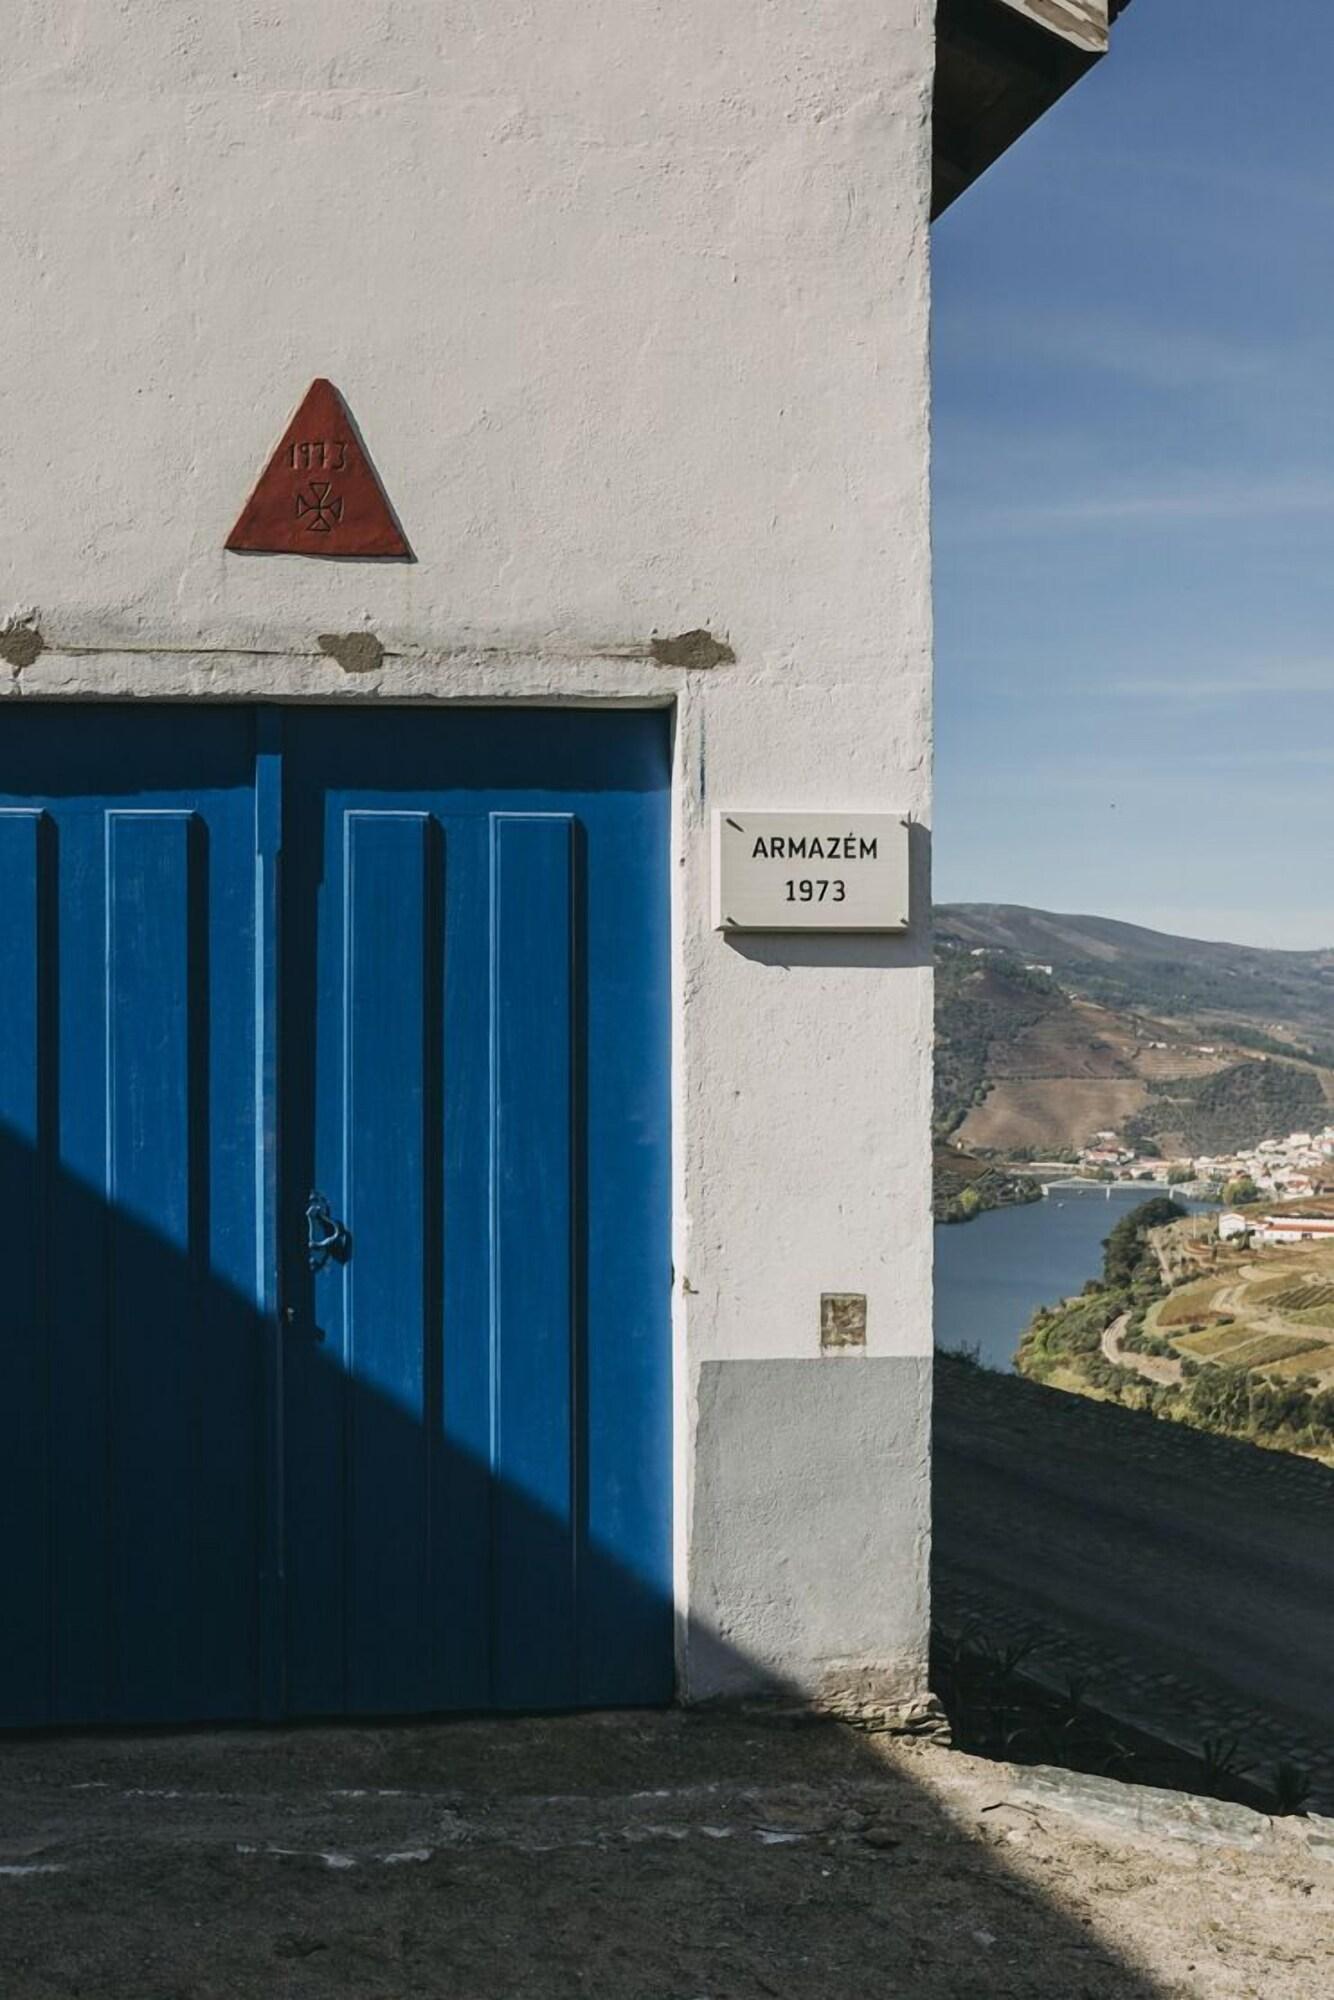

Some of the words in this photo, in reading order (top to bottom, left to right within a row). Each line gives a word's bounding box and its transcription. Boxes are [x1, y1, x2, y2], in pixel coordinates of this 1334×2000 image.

[289, 442, 348, 471] 1973
[752, 832, 878, 859] ARMAZÉM
[785, 880, 846, 902] 1973
